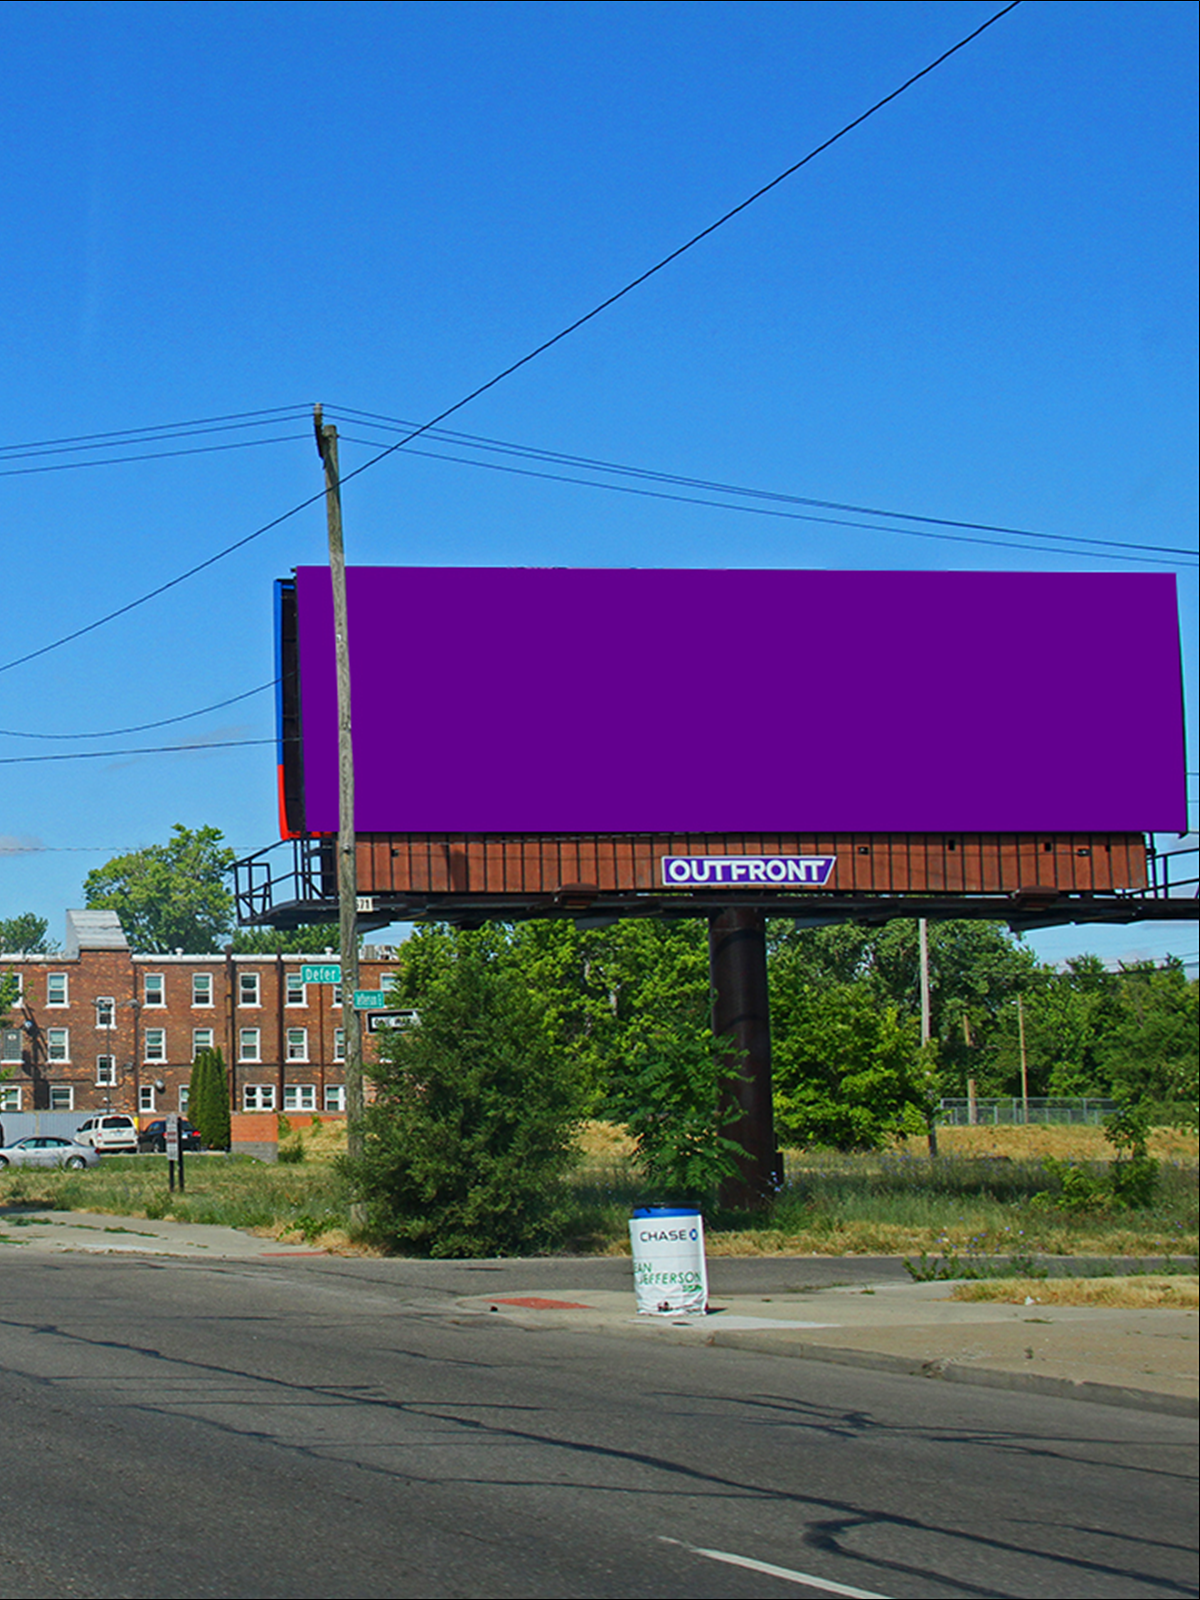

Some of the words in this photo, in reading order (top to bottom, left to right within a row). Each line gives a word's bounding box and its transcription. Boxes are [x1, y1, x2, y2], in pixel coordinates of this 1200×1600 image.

[668, 859, 825, 882] OUTFRONT
[305, 968, 336, 981] Defer
[640, 1230, 686, 1242] CHASE
[639, 1272, 701, 1285] JEFFERSON
